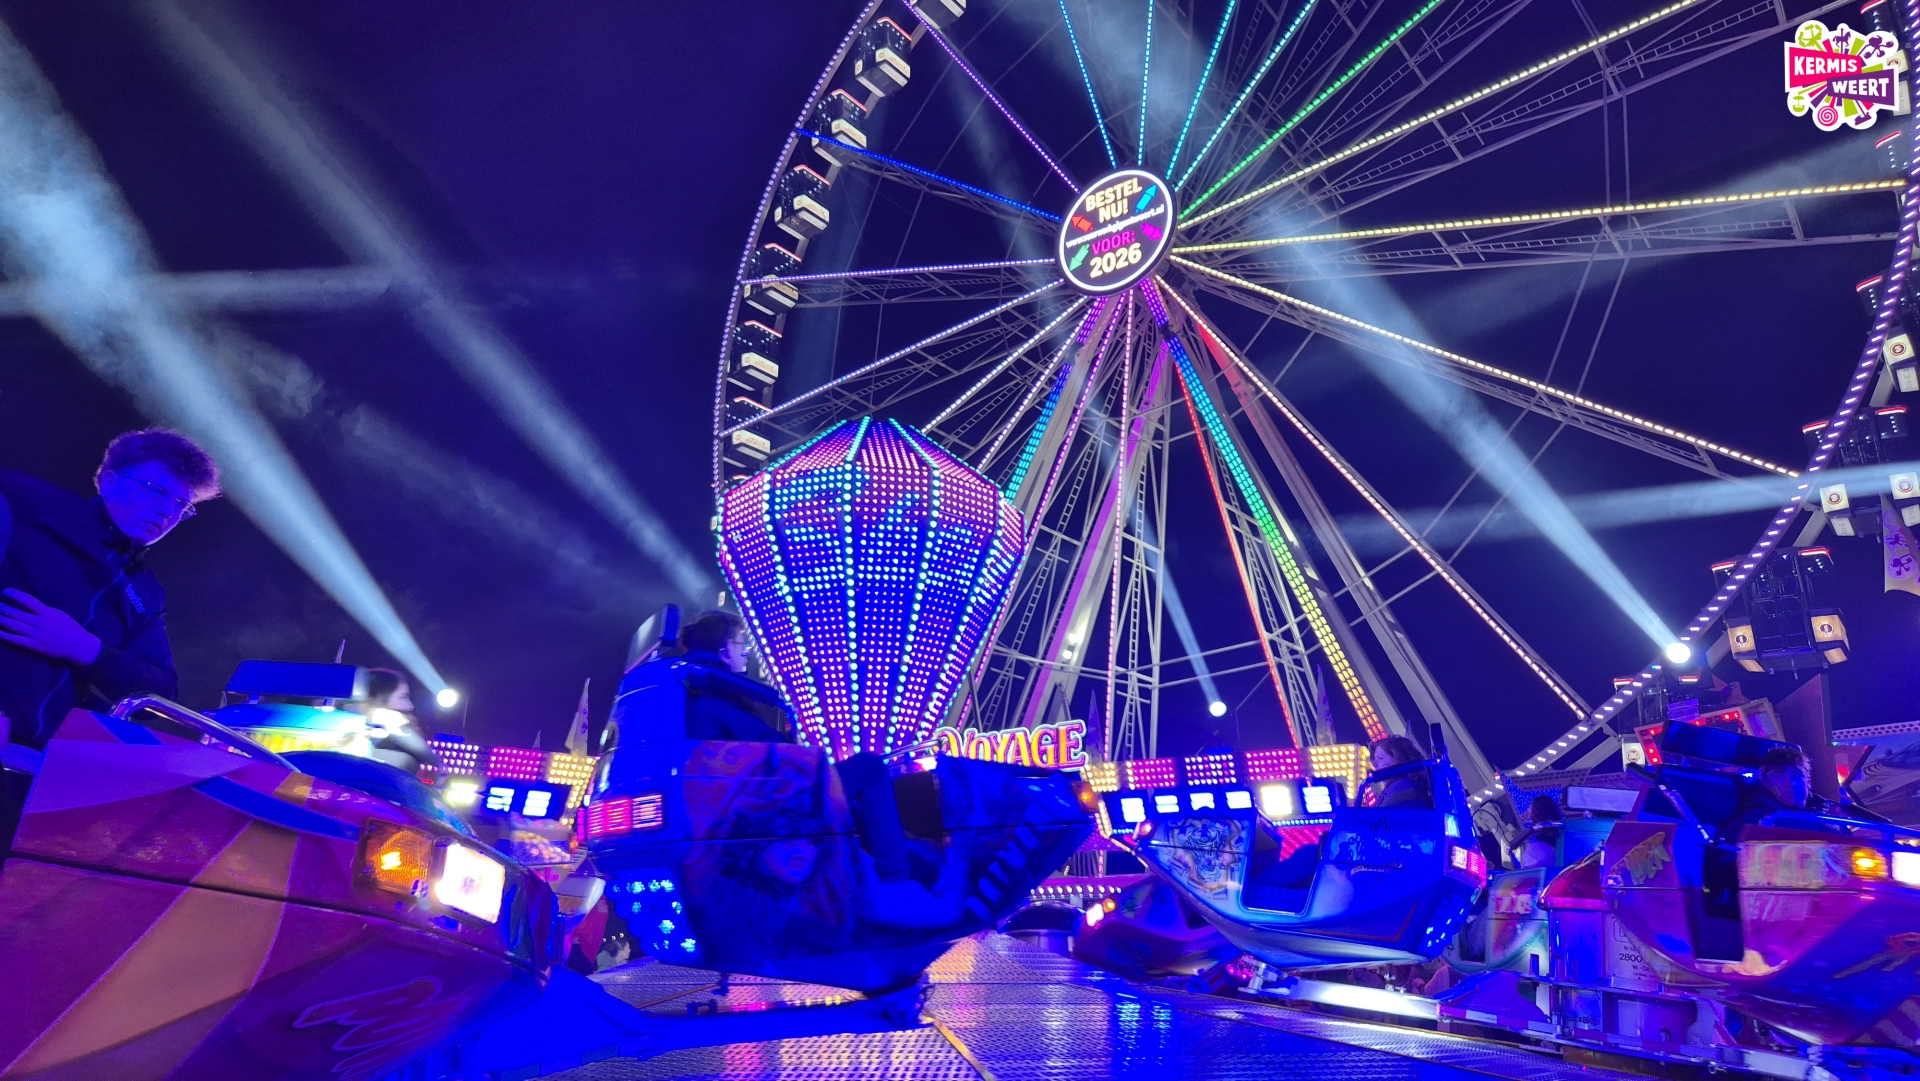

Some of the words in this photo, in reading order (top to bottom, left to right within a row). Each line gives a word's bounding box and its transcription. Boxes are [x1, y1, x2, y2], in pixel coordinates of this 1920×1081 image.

[1085, 177, 1143, 212] BESTEL
[1098, 198, 1129, 223] NU!
[1091, 231, 1136, 255] VOOR:
[1090, 242, 1142, 278] 2026
